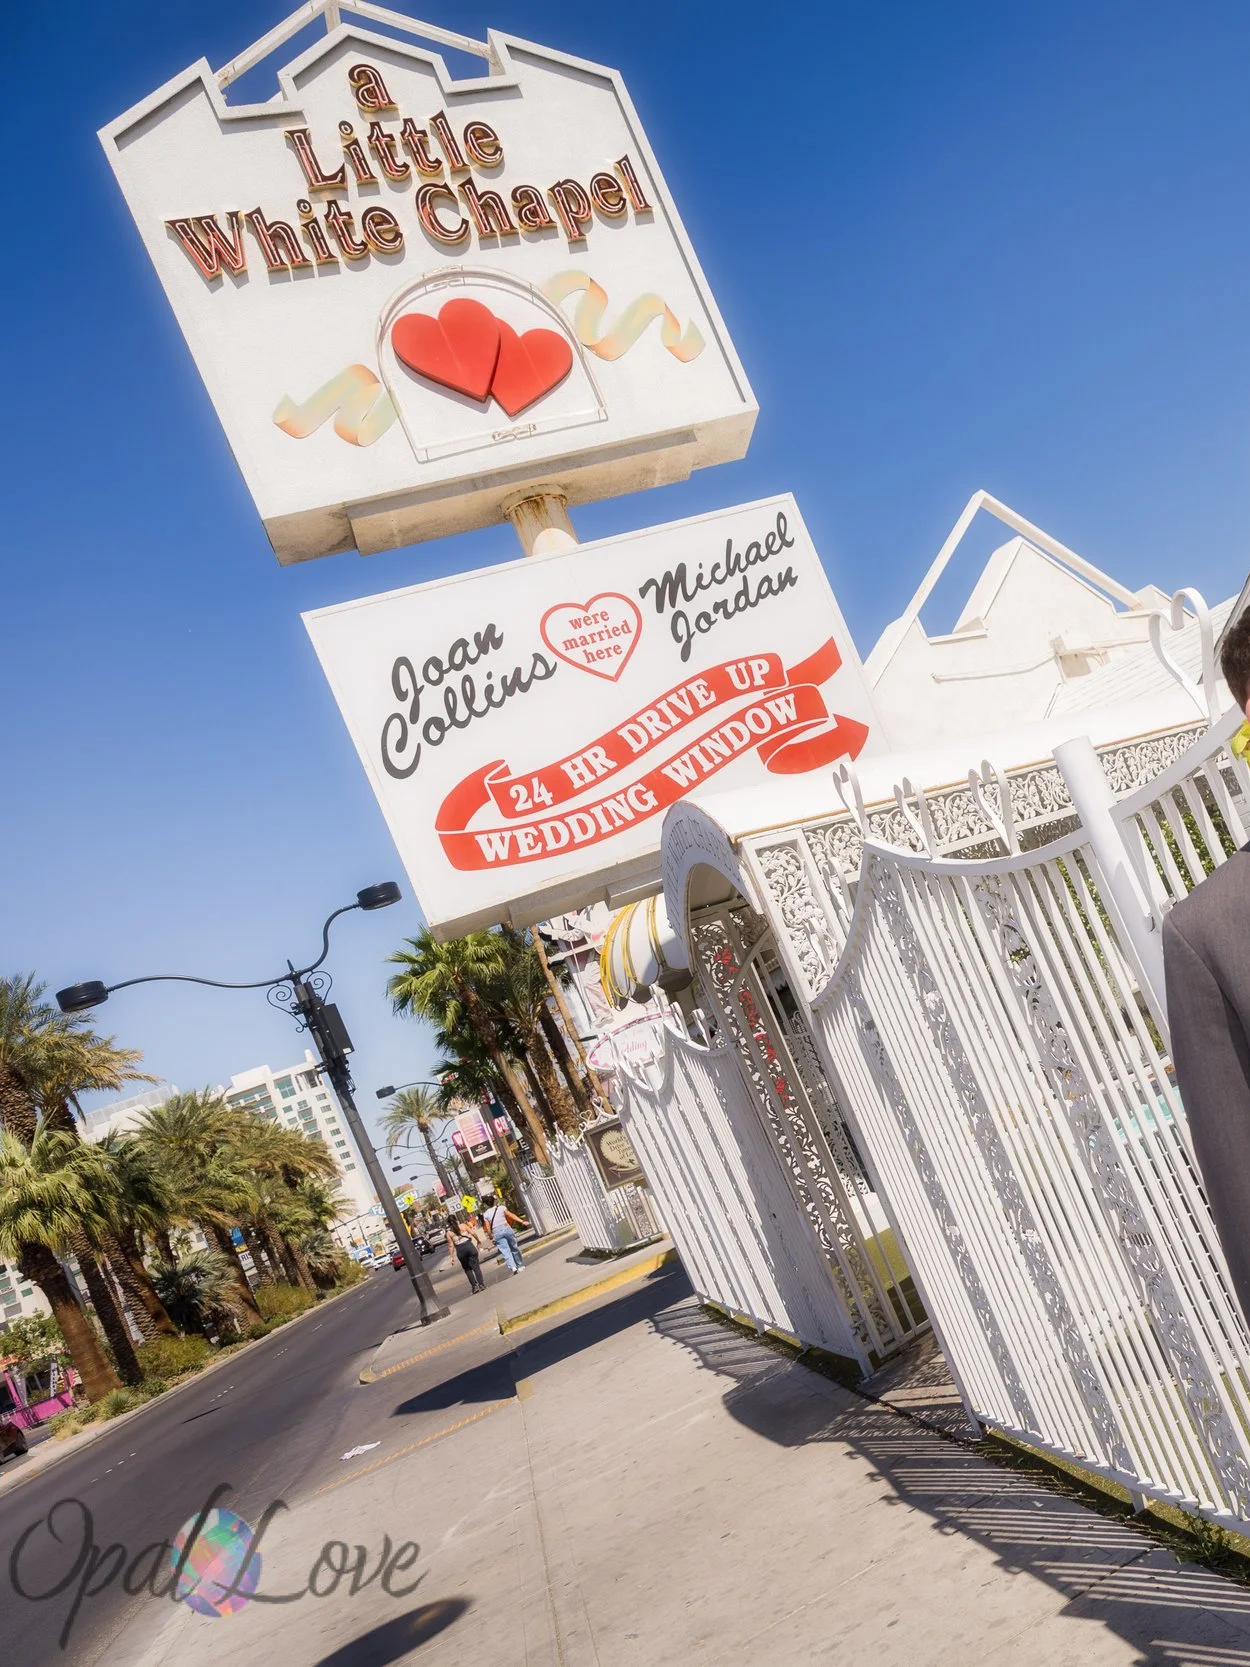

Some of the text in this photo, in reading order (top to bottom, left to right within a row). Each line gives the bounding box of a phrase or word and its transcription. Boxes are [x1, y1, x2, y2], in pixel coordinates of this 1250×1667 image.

[349, 62, 397, 112] a
[284, 111, 503, 192] Little
[167, 155, 654, 281] White Chapel
[639, 511, 794, 614] Michael
[380, 619, 632, 780] Collins married
[391, 565, 798, 725] Joan were Jordan
[583, 642, 623, 664] here
[475, 694, 799, 866] WEDDING WINDOW
[509, 657, 772, 814] 24 HR DRIVE UP
[451, 1203, 462, 1212] 30
